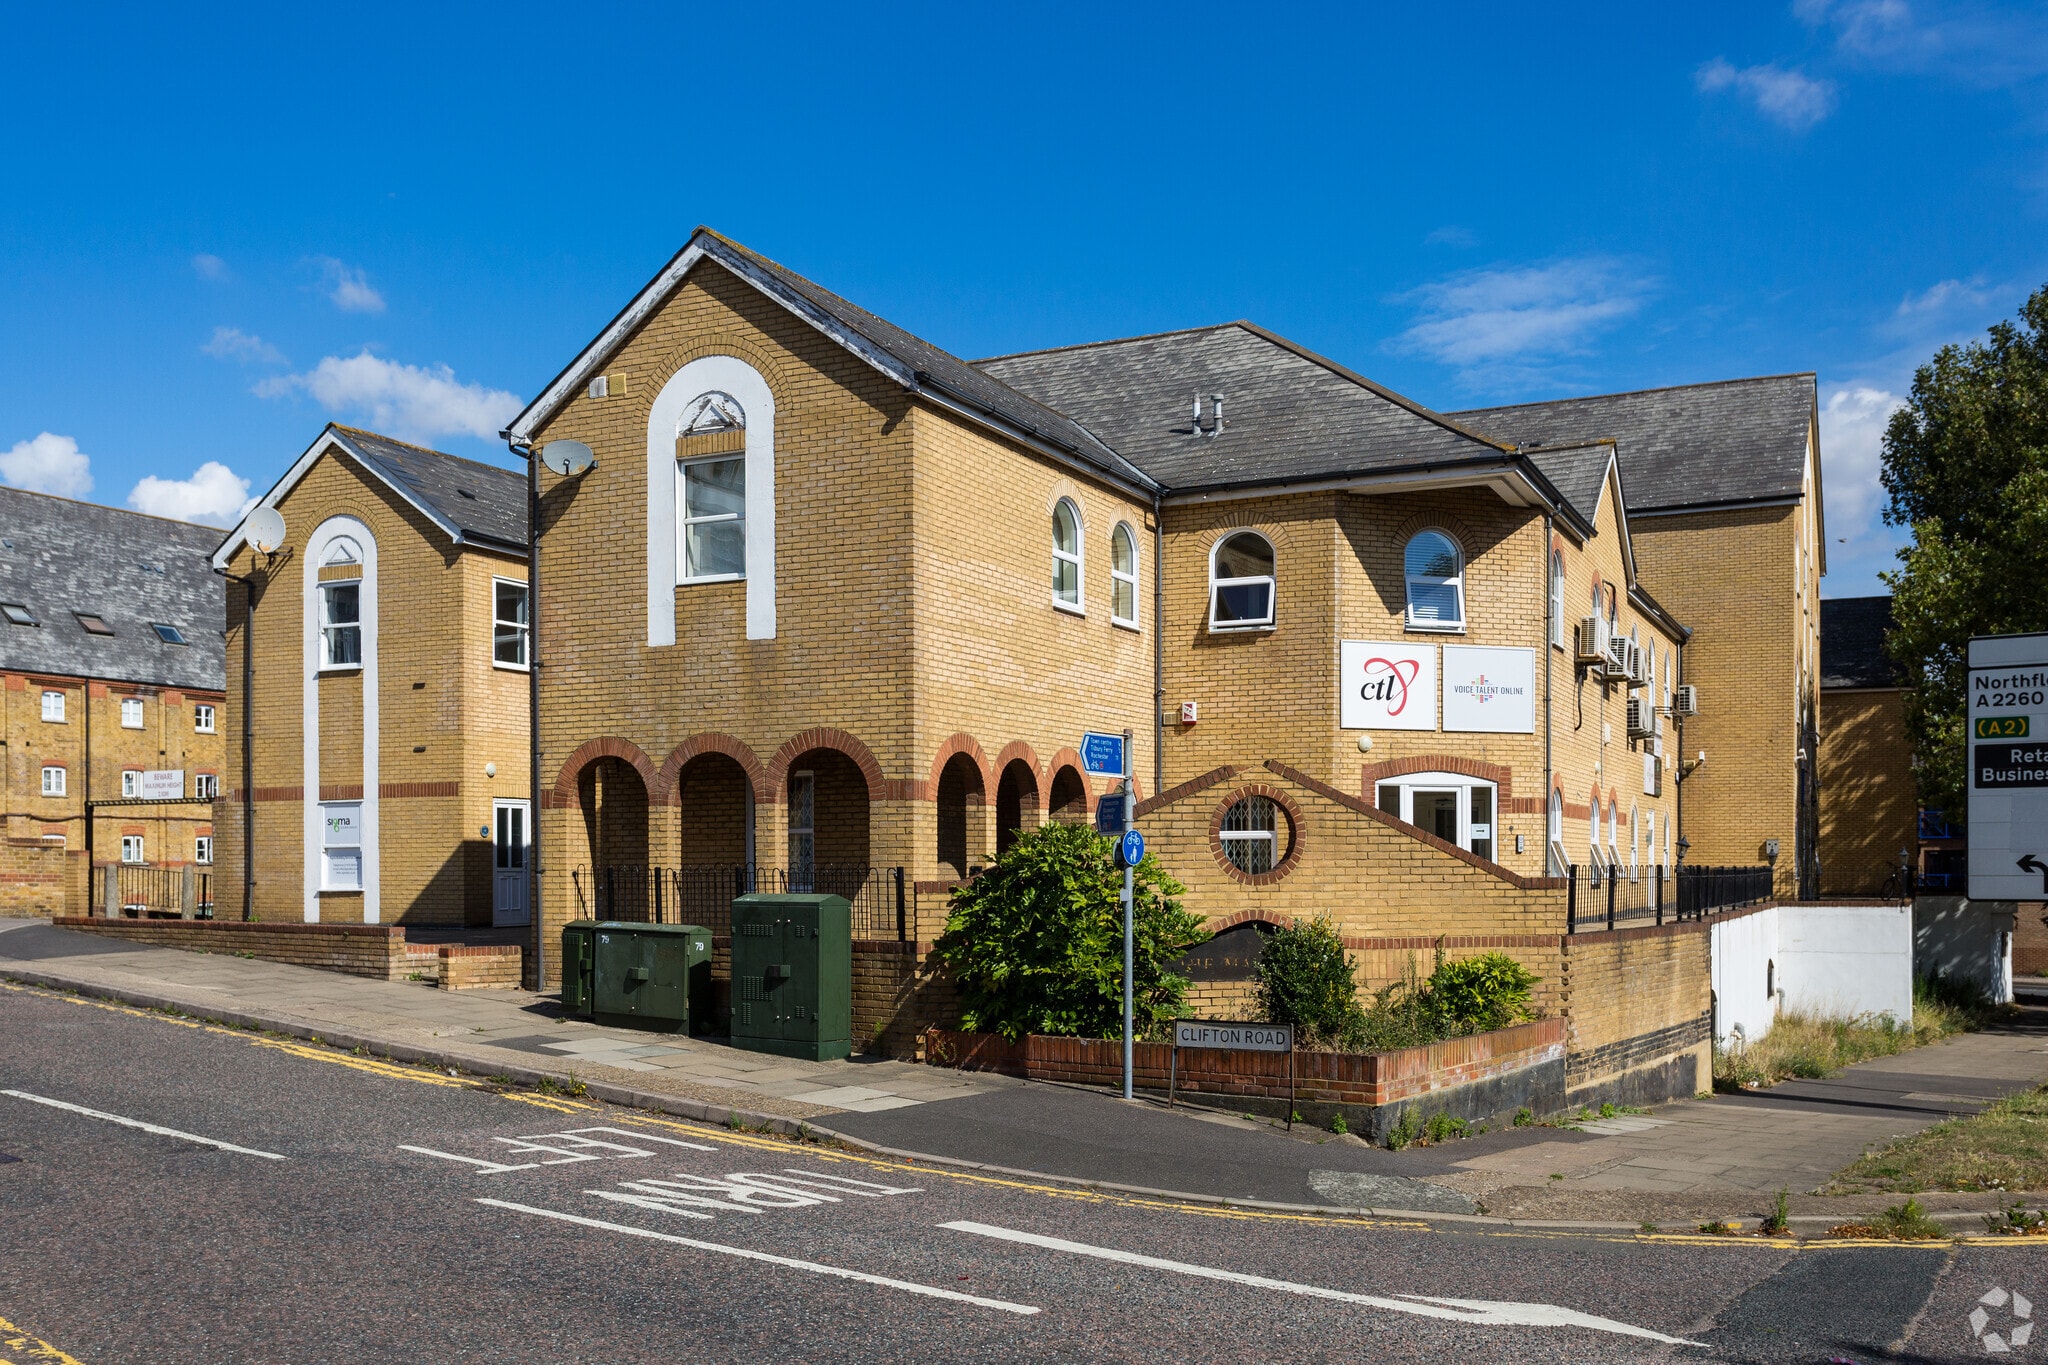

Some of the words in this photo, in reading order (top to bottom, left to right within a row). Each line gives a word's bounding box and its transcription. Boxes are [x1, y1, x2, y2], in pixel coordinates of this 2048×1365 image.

[1975, 673, 2048, 689] Northfl
[1361, 675, 1396, 701] ctl
[1454, 685, 1474, 694] VOICE
[1476, 685, 1499, 695] TALENT
[1500, 686, 1524, 696] ONLINE
[1976, 691, 2045, 708] A2260
[1977, 718, 2027, 737] (A2)
[1090, 737, 1100, 745] Town
[1104, 746, 1113, 755] Ferry
[153, 772, 173, 781] BEWARE
[167, 781, 183, 789] HEIGHT
[601, 935, 610, 944] 79
[695, 942, 704, 951] 79
[1181, 1027, 1241, 1044] CLIFTON
[1245, 1030, 1286, 1046] ROAD
[396, 1126, 719, 1175] LEFT
[583, 1168, 927, 1220] TURN
